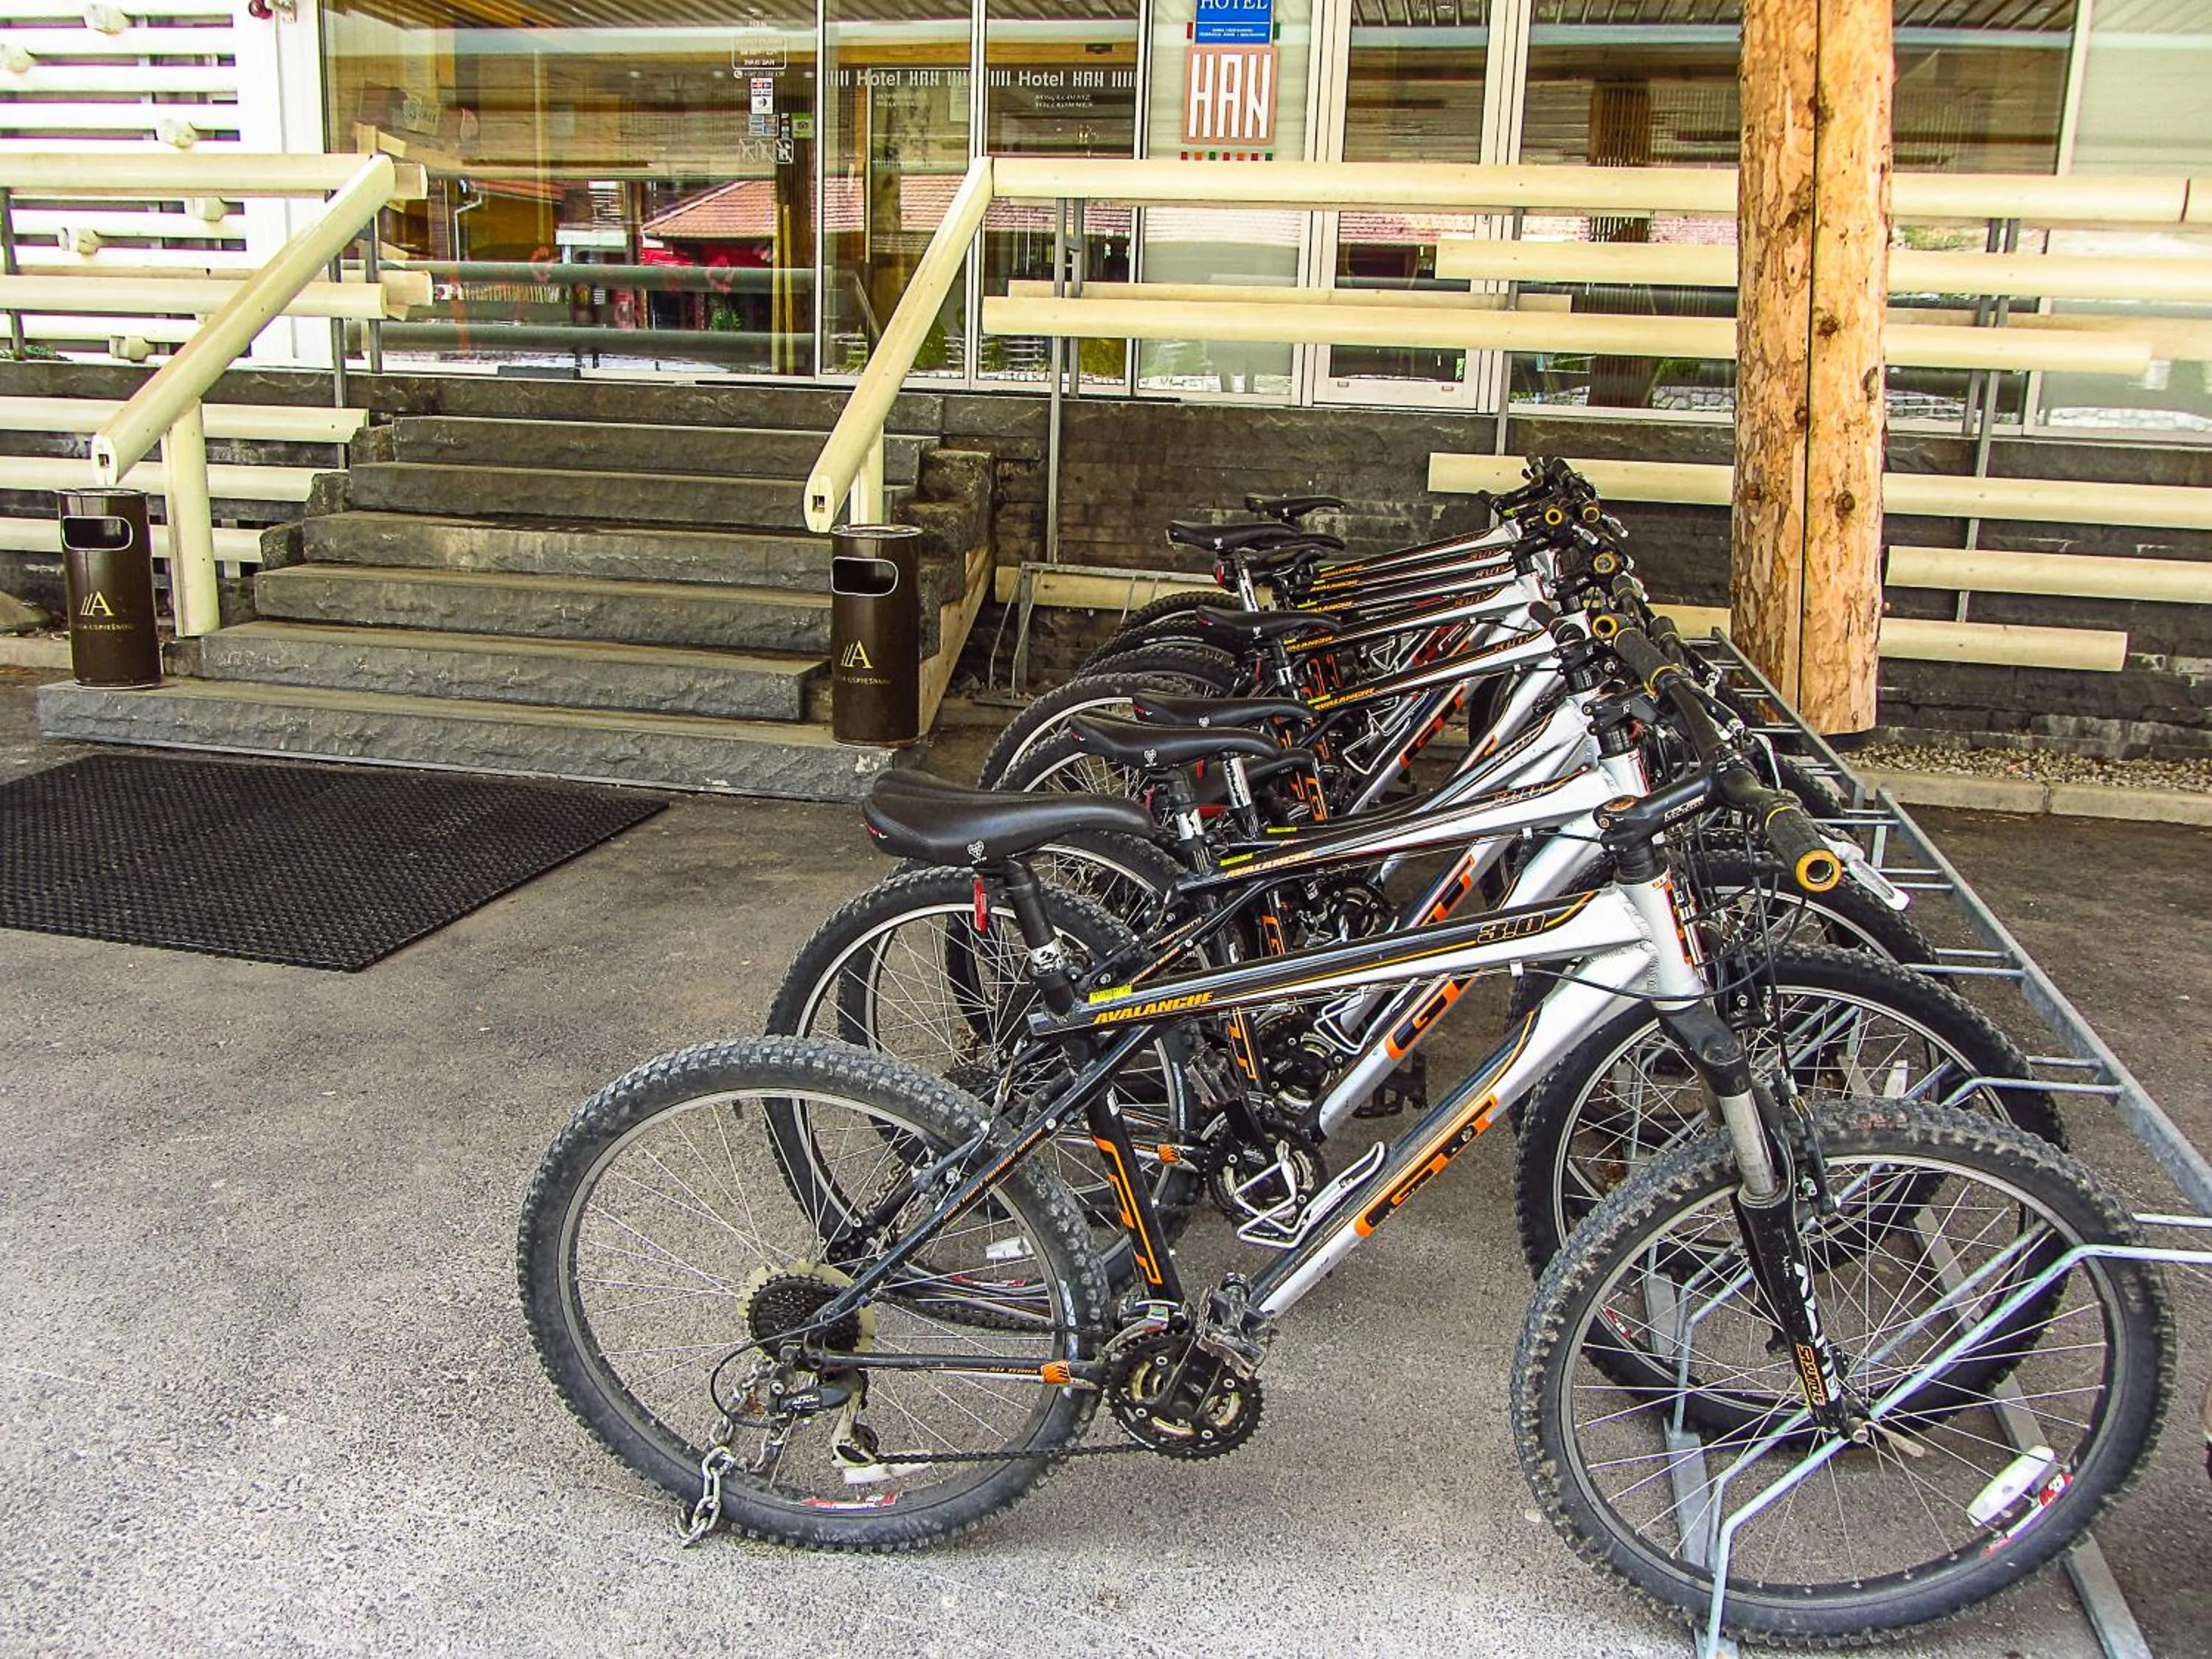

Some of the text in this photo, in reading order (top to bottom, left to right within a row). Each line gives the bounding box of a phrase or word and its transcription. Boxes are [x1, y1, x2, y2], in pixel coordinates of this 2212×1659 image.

[857, 70, 939, 86] Hotel HAN
[1018, 70, 1104, 87] Hotel HAN
[1188, 53, 1272, 139] HAN
[1226, 848, 1315, 878] AVALANCHE
[1478, 912, 1546, 944] 3.0
[1093, 991, 1214, 1024] AVALANCHE
